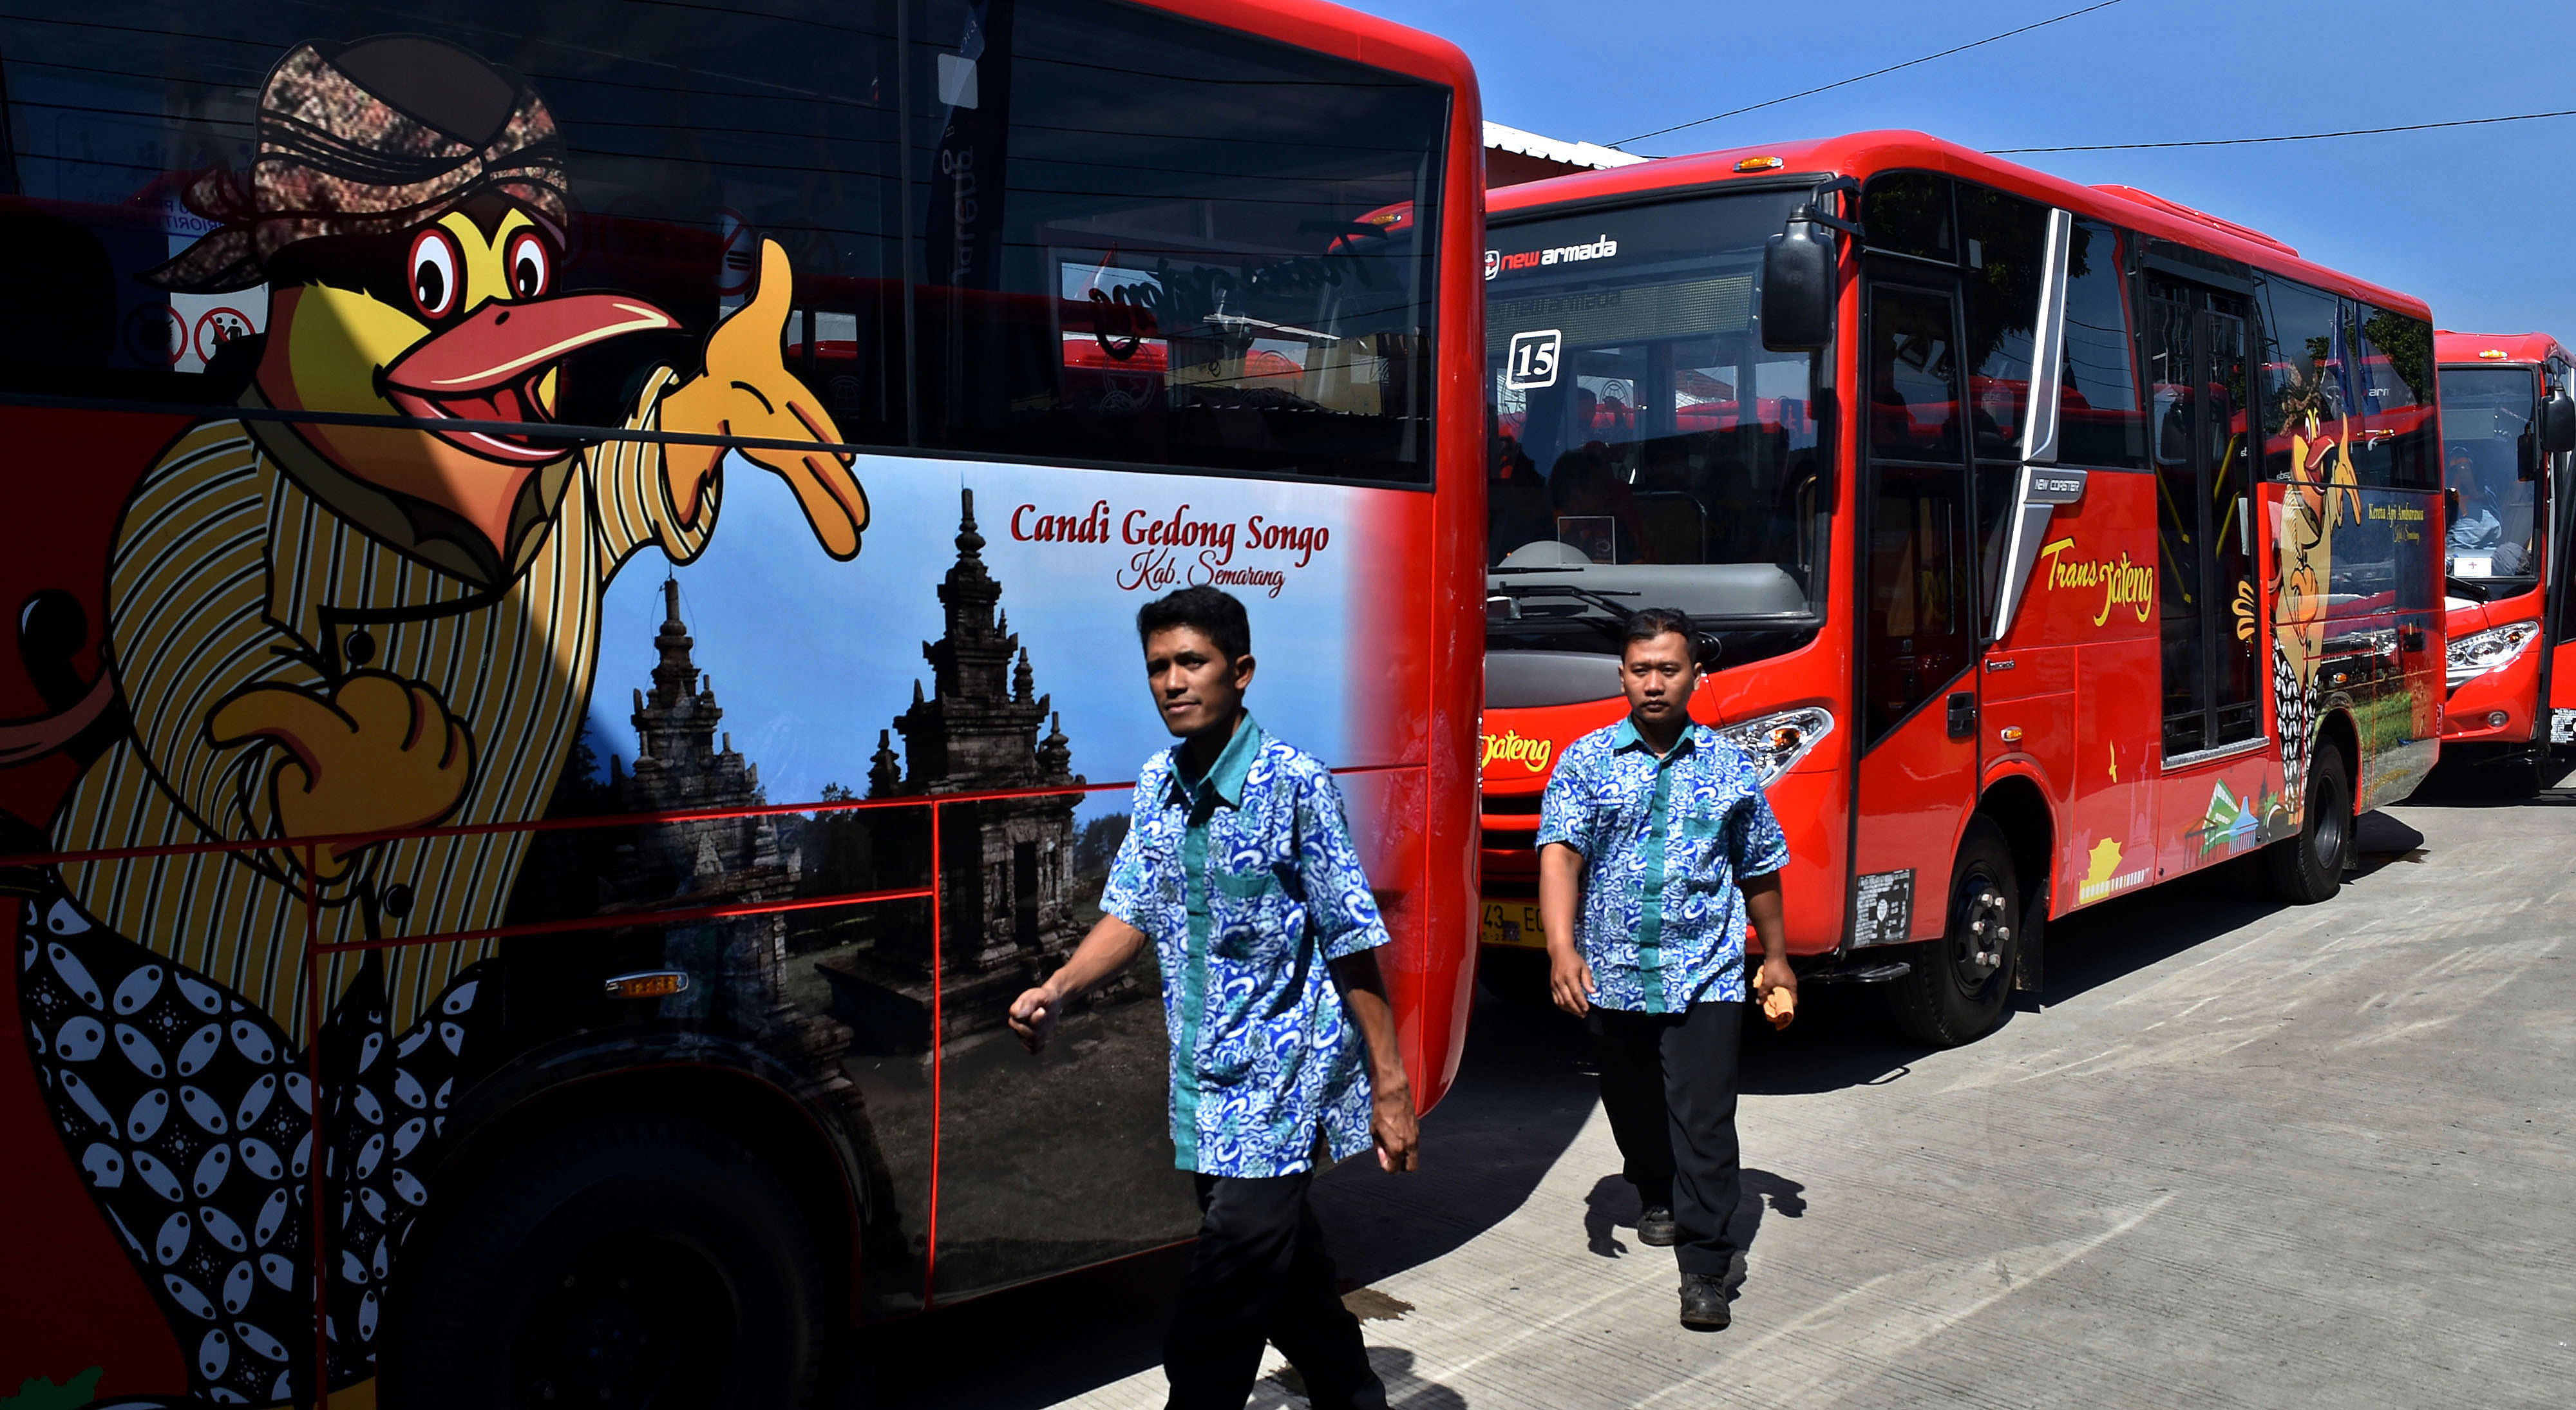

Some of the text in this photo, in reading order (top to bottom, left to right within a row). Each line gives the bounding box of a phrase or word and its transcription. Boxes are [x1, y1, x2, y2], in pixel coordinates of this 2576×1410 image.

[1501, 233, 1617, 271] new armada
[1516, 342, 1555, 376] 15
[1010, 500, 1329, 567] Candi Gedong Songo
[1116, 548, 1285, 598] Kab. Semarang
[2041, 537, 2098, 591] Trans
